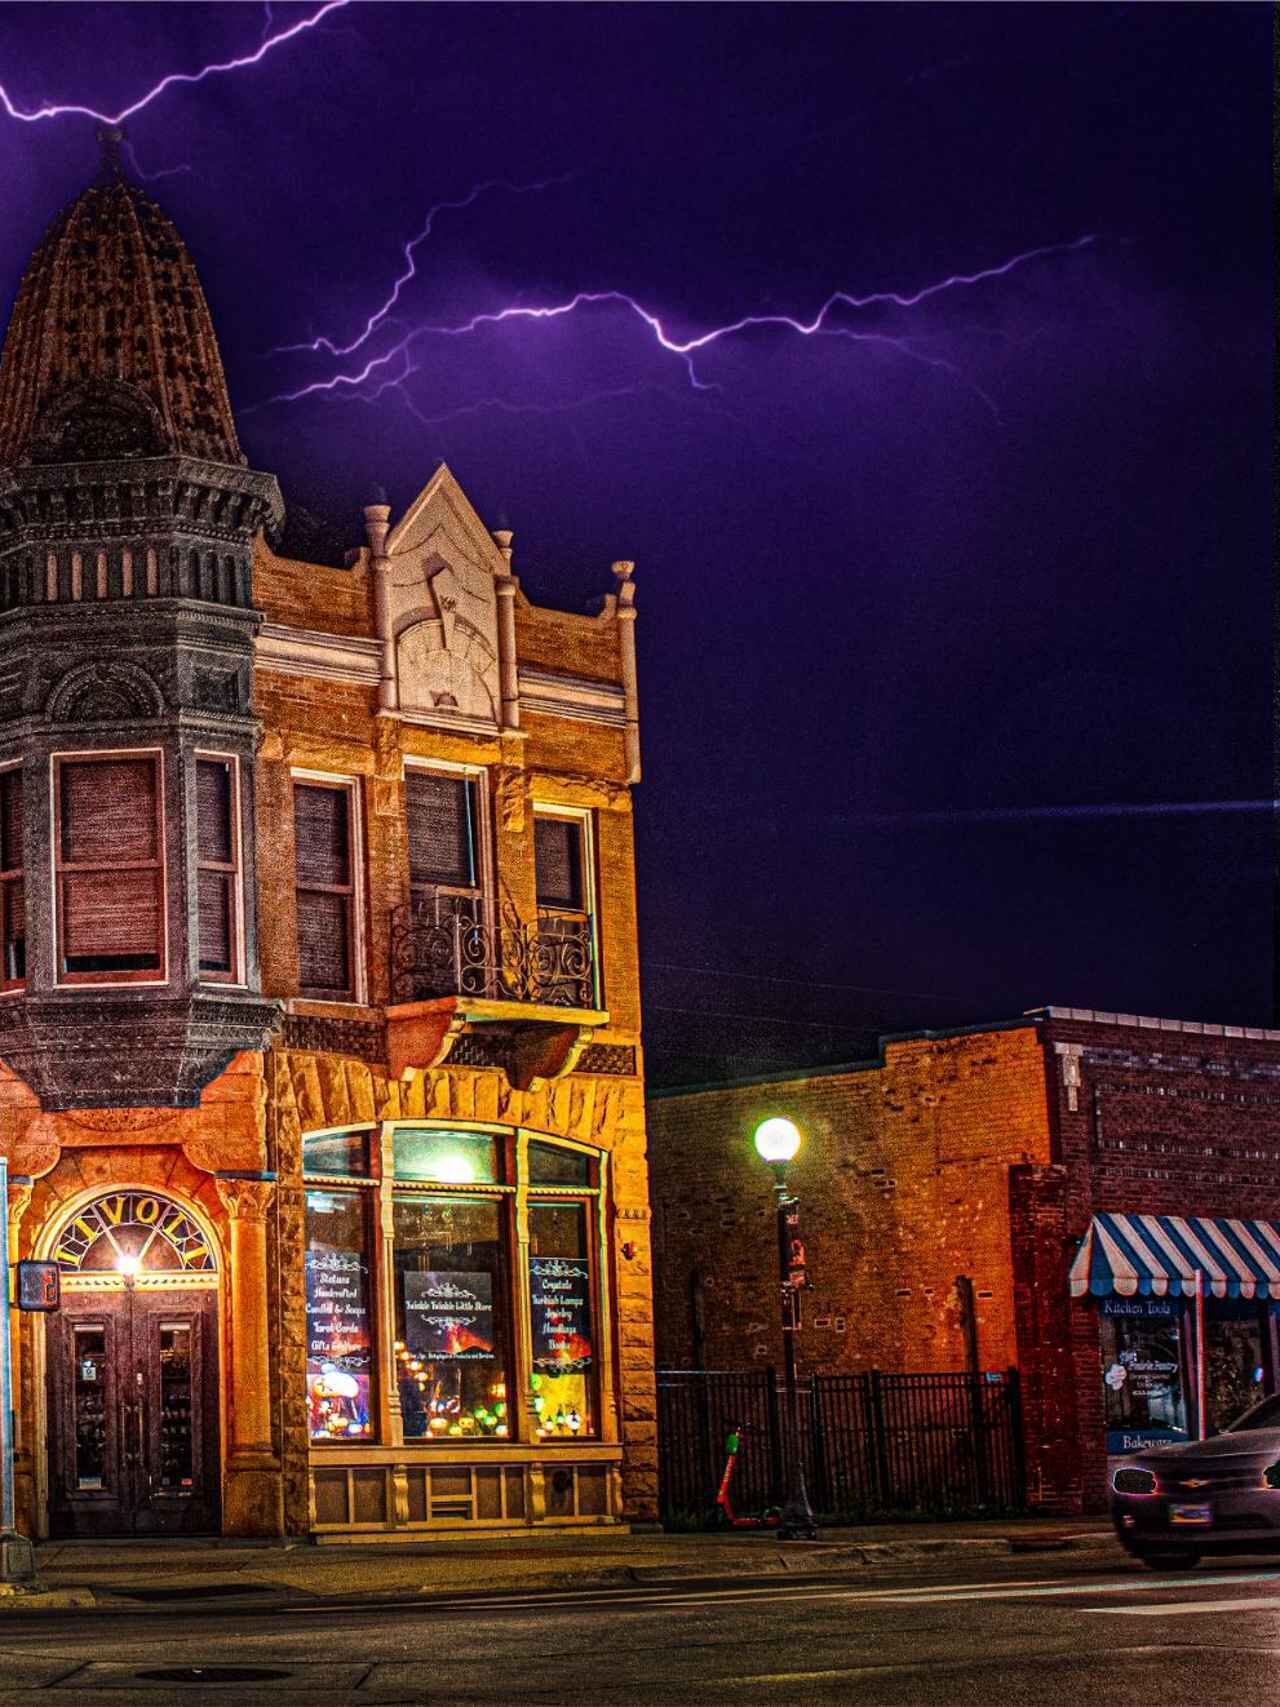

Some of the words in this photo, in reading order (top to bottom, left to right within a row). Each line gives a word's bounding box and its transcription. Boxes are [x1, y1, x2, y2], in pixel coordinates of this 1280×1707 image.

[55, 1197, 209, 1266] TIVOLI
[1104, 1301, 1143, 1314] Kitchen
[1145, 1301, 1171, 1315] Tools
